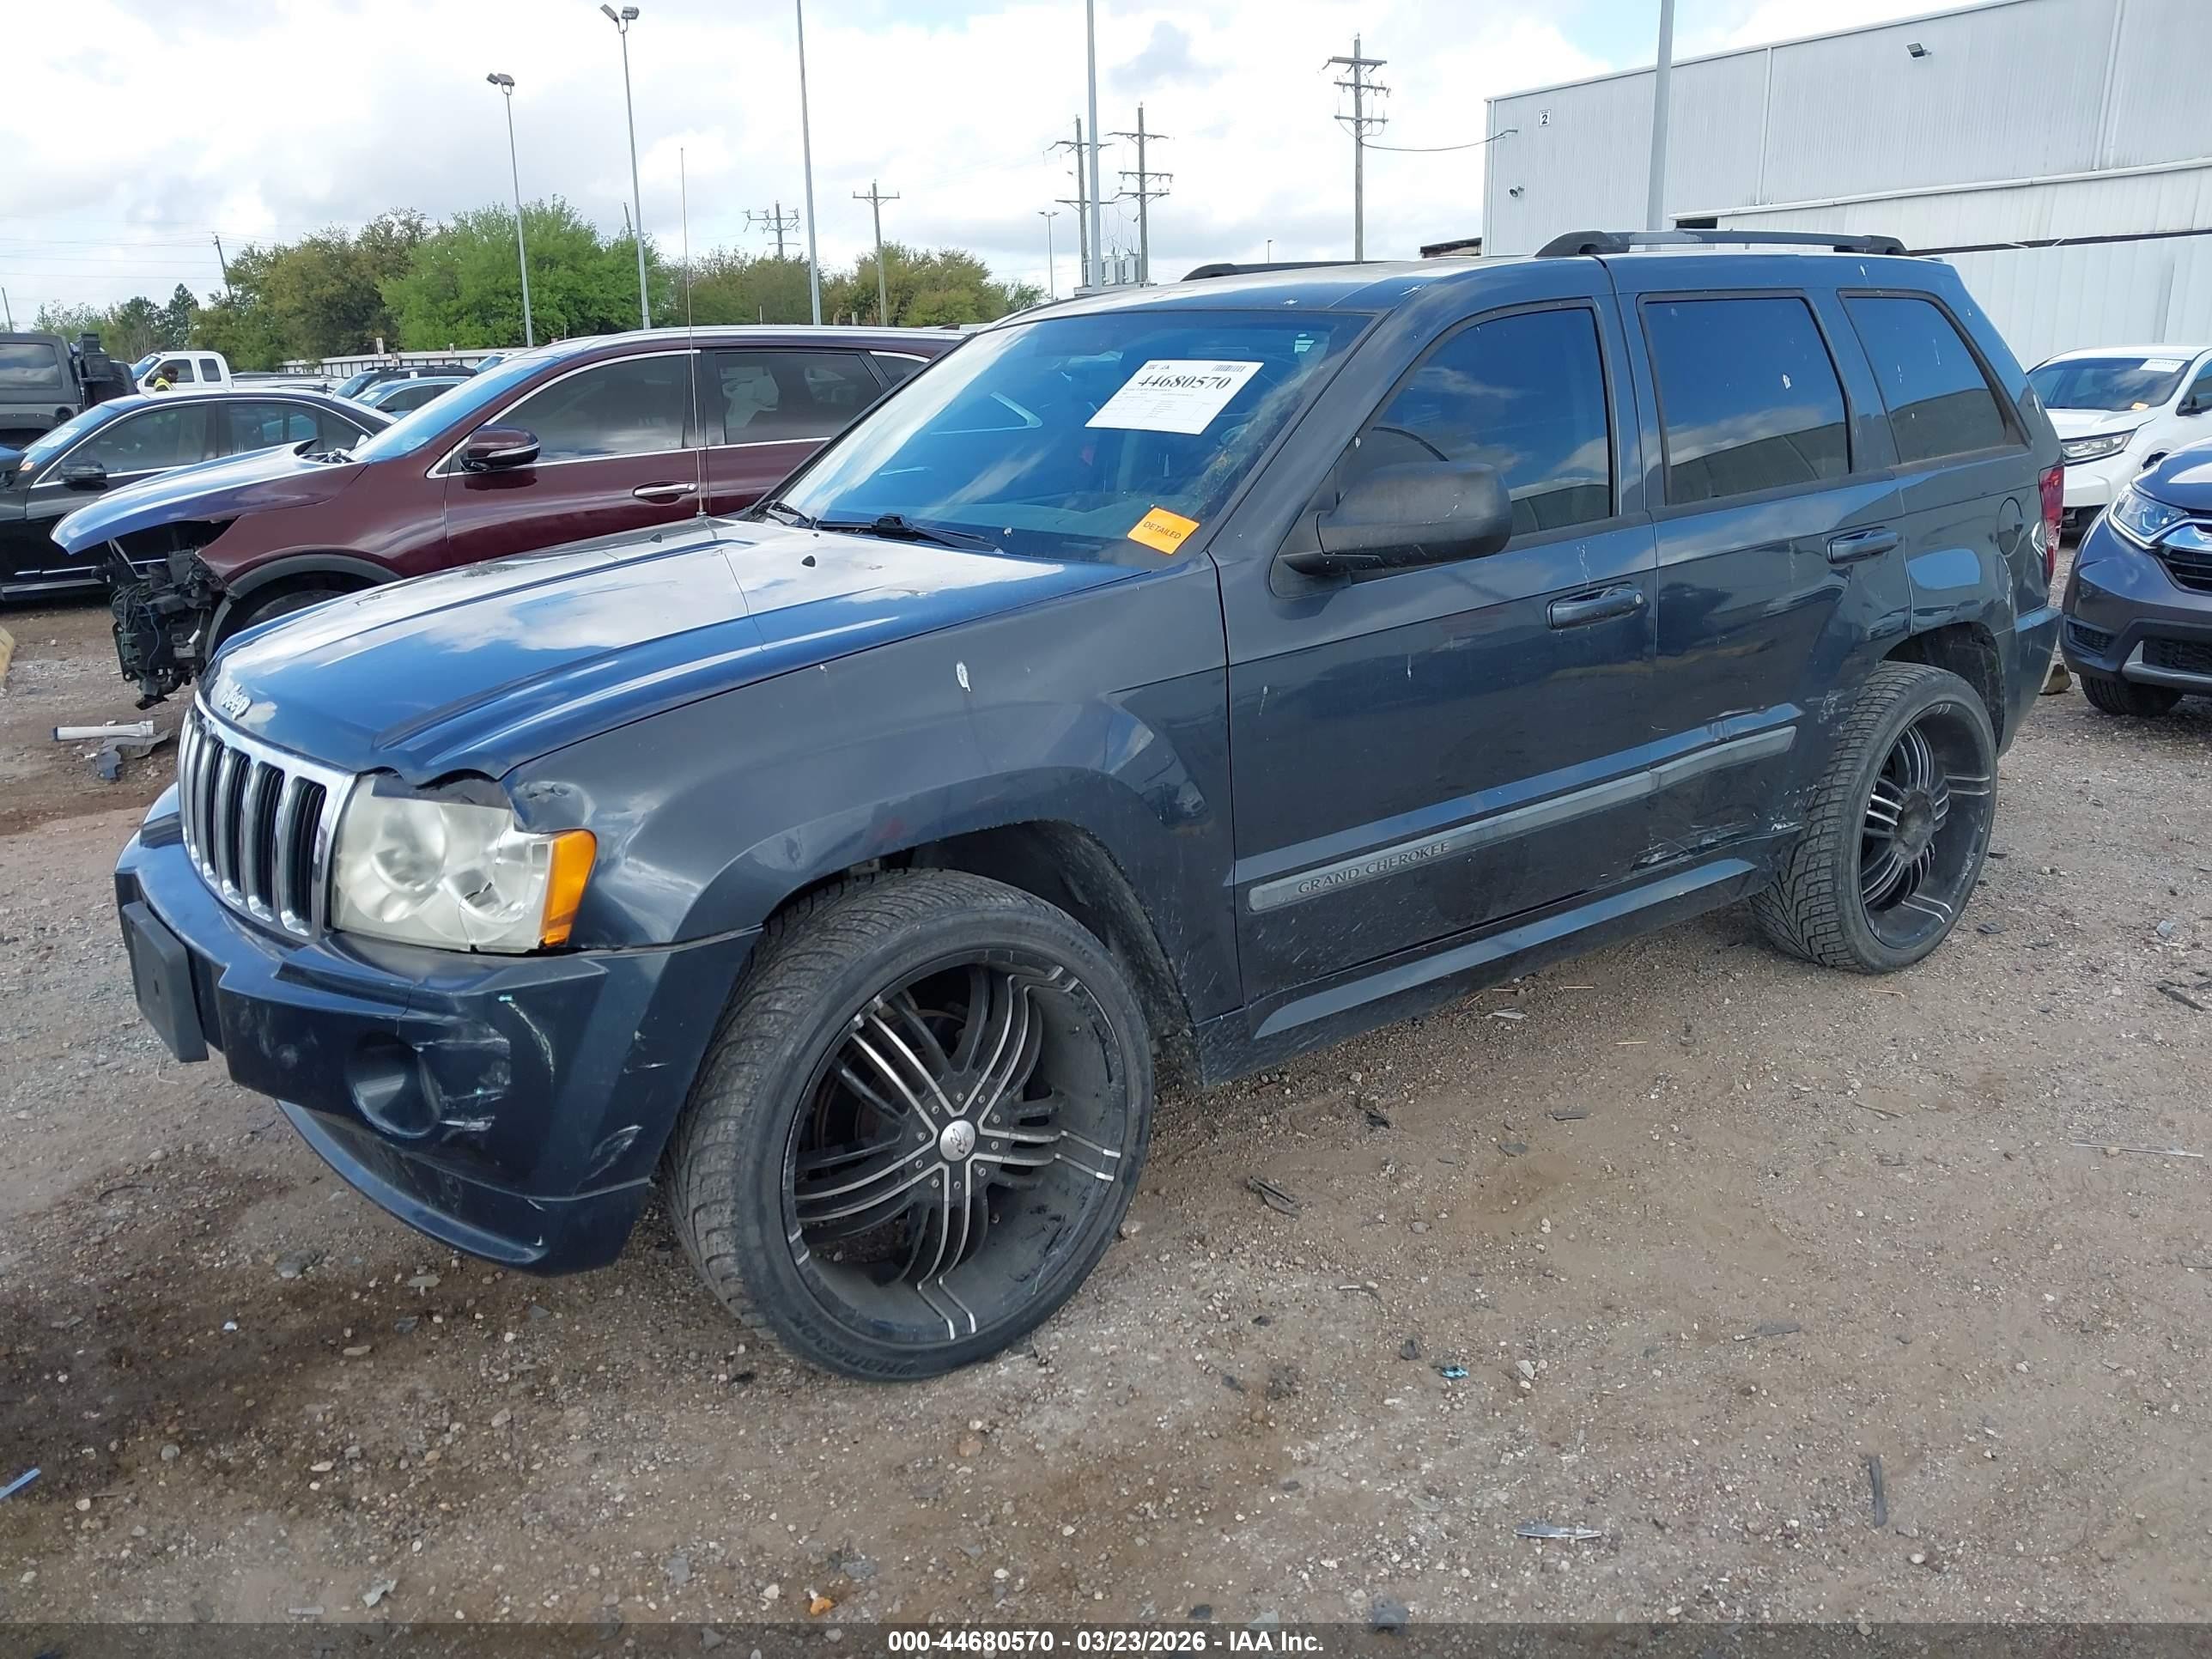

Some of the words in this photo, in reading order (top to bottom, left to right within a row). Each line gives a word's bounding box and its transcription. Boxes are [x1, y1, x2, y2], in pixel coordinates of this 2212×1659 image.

[1541, 114, 1548, 125] 2
[1138, 374, 1231, 391] 44680570
[1143, 521, 1182, 539] DETAILED
[1297, 867, 1360, 894] GRAND
[1365, 842, 1449, 874] CHEROKEE
